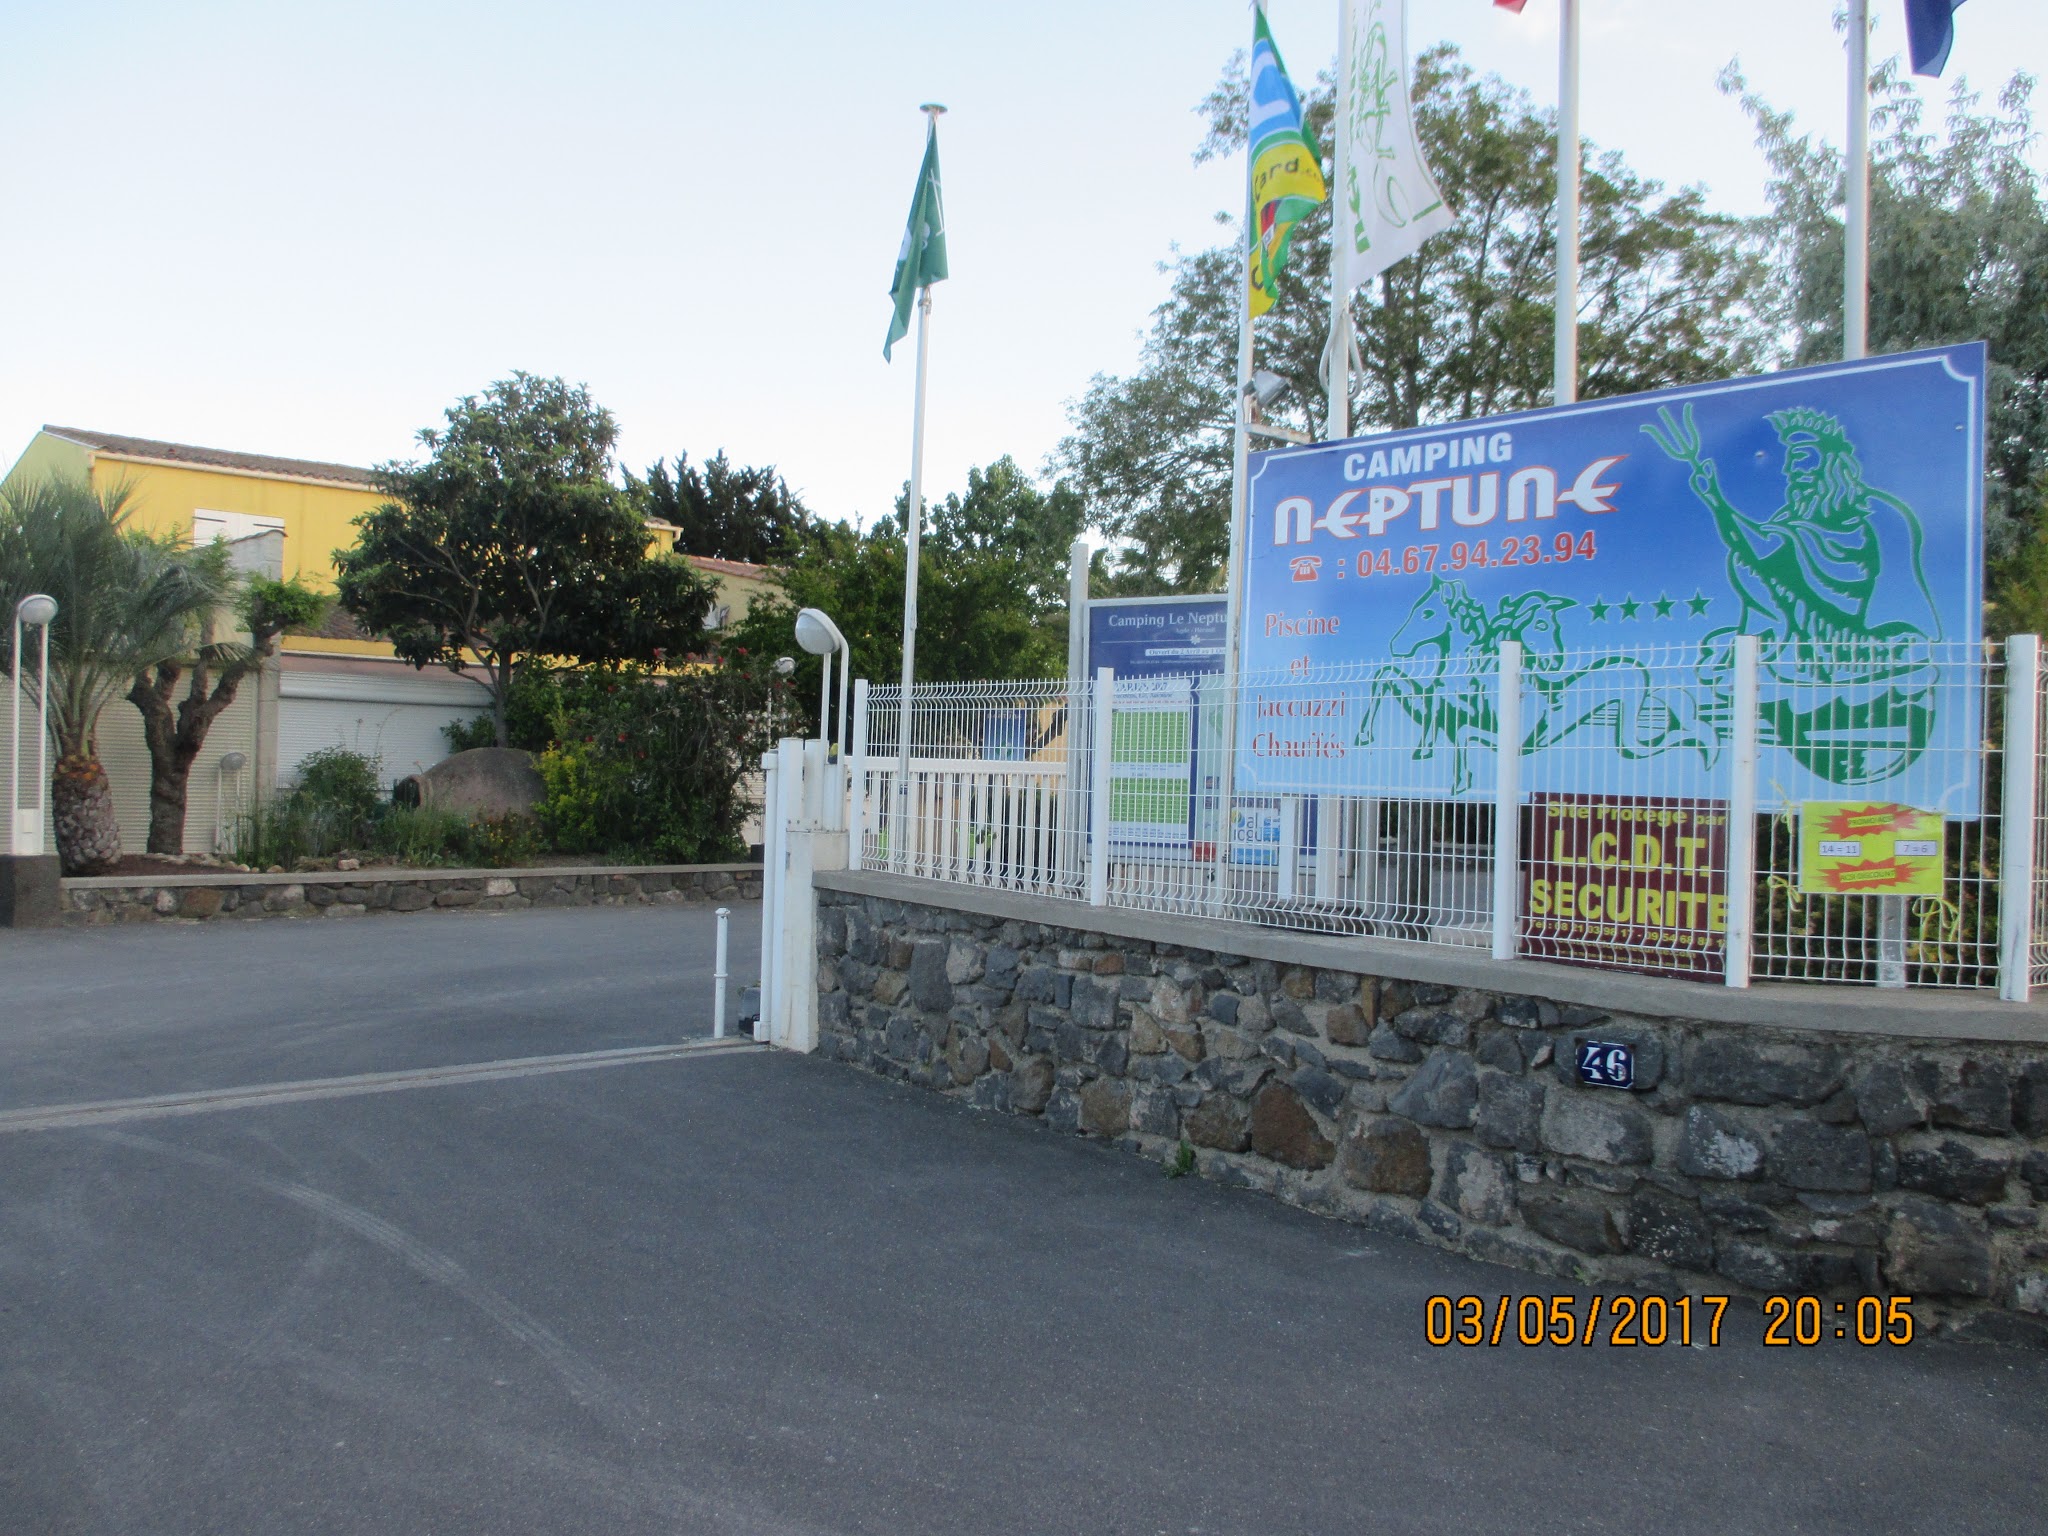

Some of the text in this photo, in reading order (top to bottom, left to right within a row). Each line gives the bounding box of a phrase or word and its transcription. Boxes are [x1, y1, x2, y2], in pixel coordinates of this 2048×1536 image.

[1344, 432, 1513, 482] CAMPING
[1273, 454, 1631, 546] NEPTUNE
[1356, 530, 1597, 579] 04.67.94.23.94
[1108, 610, 1228, 628] Camping Le Neptu
[1264, 609, 1341, 638] Piscine
[1290, 655, 1310, 677] et
[1548, 801, 1589, 818] Site
[1553, 829, 1711, 877] L.C.D.T.
[1822, 845, 1833, 854] 14
[1846, 845, 1857, 854] 11
[1904, 844, 1909, 853] 7
[1921, 844, 1928, 853] 6
[1582, 1046, 1628, 1082] 46
